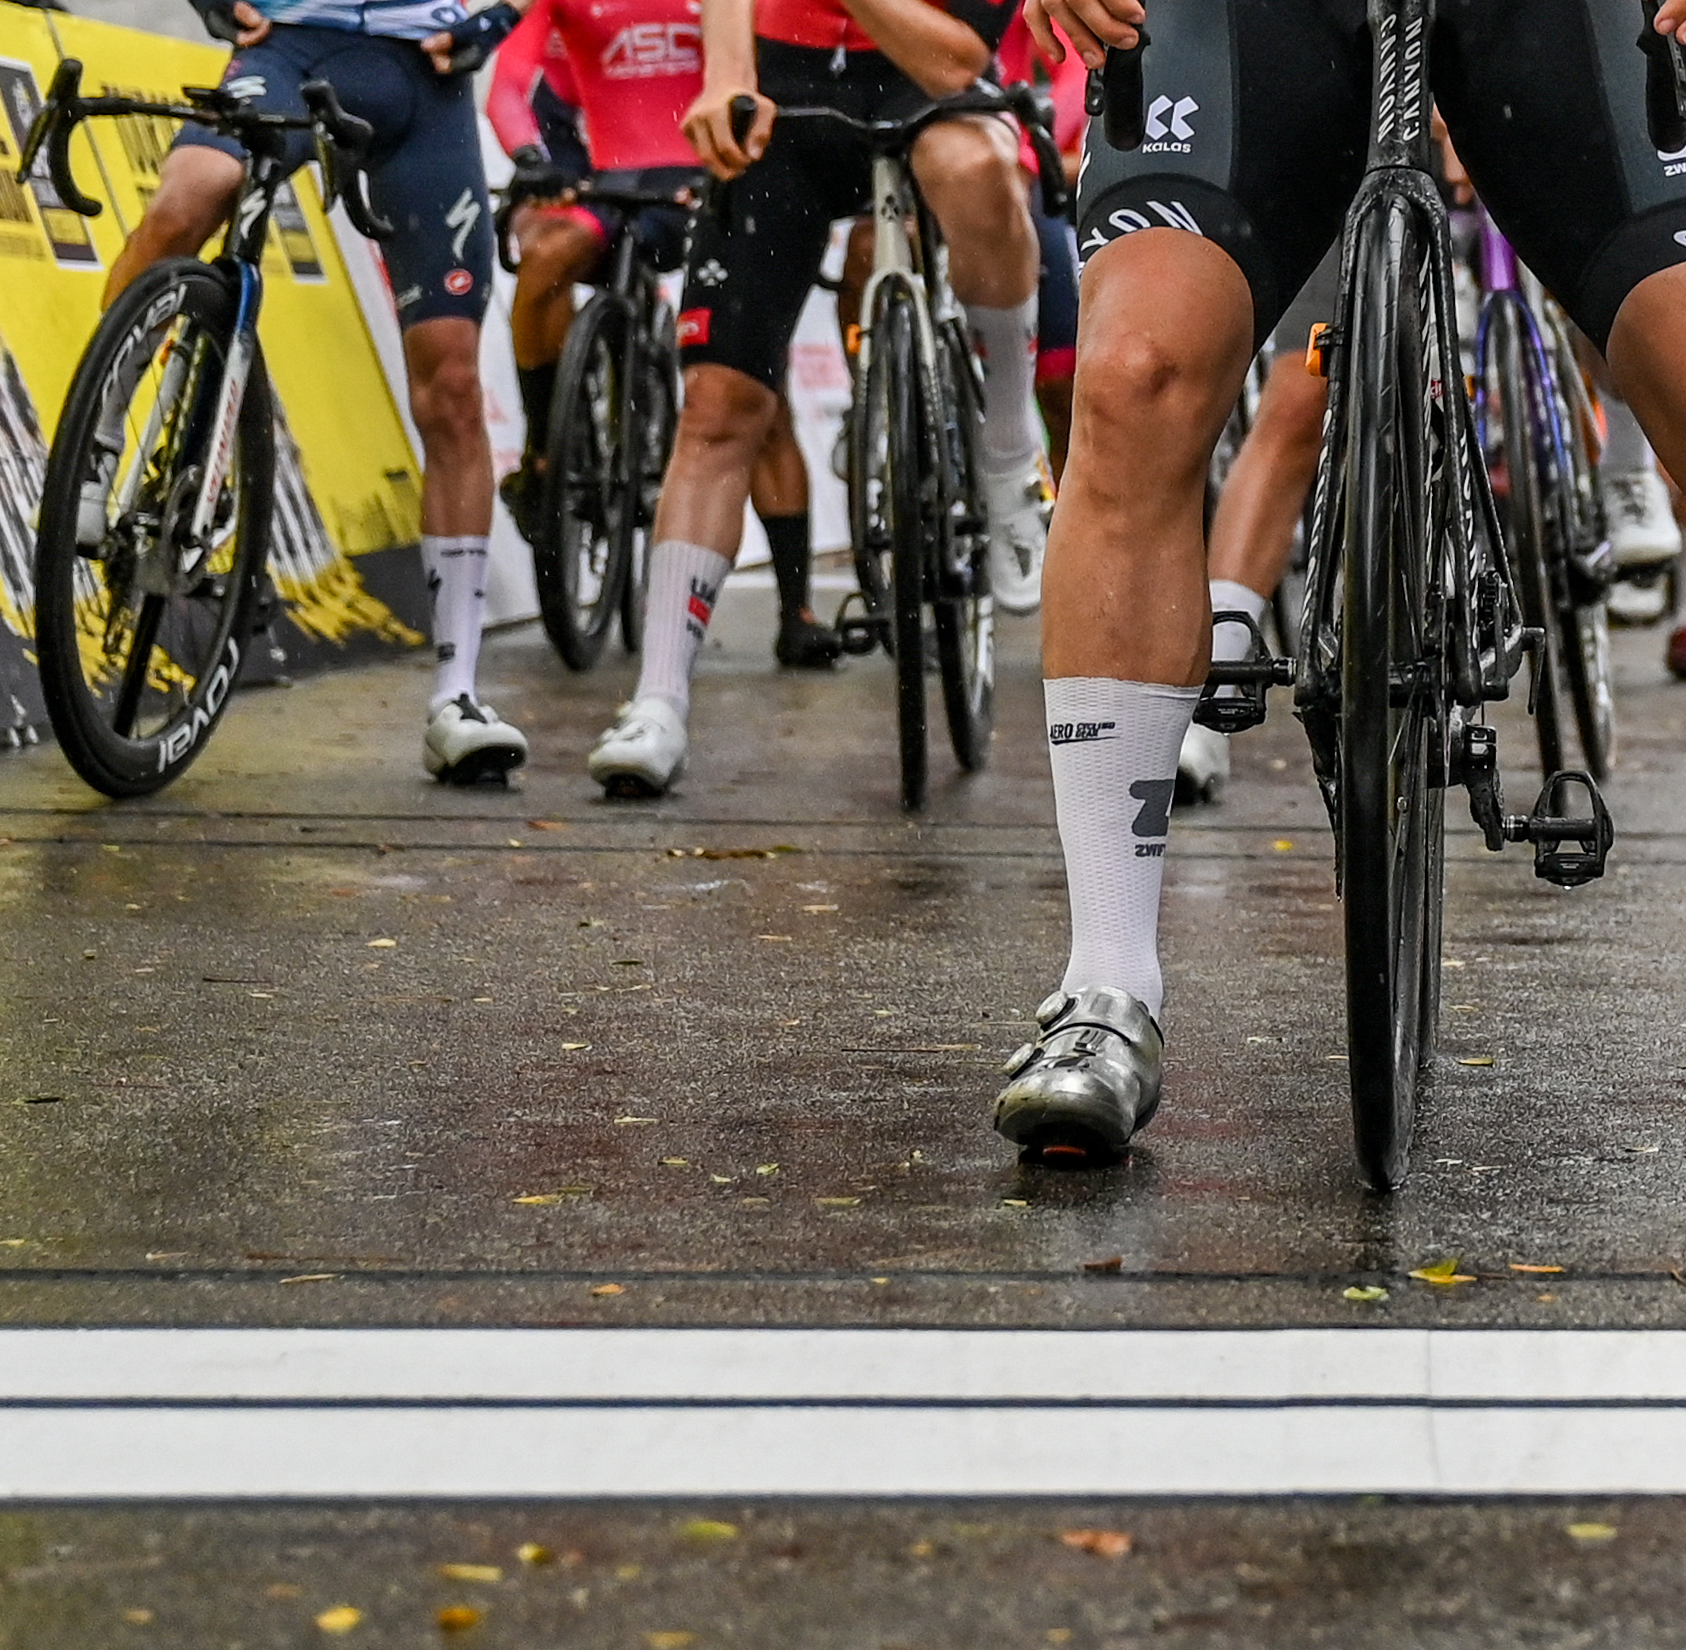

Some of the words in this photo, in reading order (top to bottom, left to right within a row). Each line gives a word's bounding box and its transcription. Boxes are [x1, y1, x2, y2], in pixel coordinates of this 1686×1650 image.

[1377, 14, 1397, 143] CANYON
[1402, 17, 1423, 141] CANYON
[159, 637, 240, 774] roval
